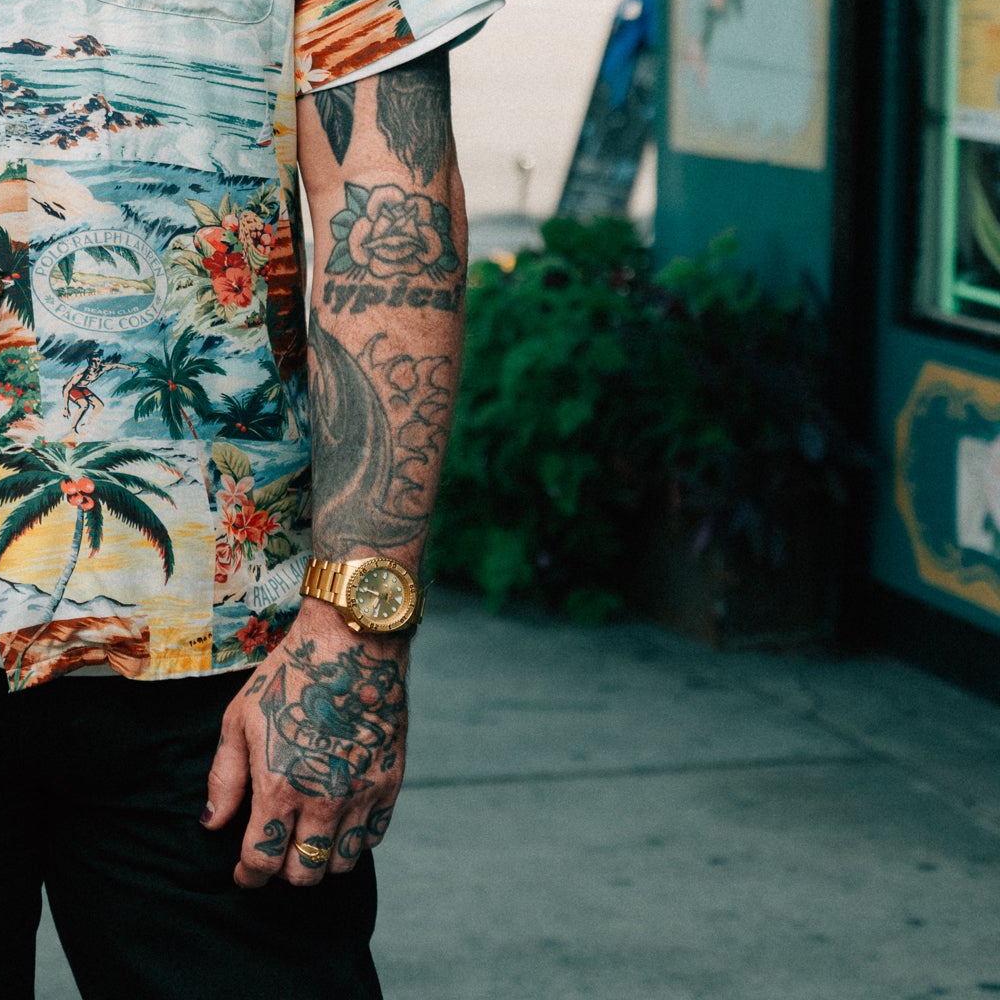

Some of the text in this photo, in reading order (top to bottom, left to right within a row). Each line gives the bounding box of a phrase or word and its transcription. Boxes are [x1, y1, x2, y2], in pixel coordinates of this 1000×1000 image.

[35, 231, 165, 278] POLO RALPH LAUREN
[54, 303, 160, 330] PACIFIC COAST
[83, 306, 140, 315] BEACH CLUB
[253, 572, 291, 608] RALPH
